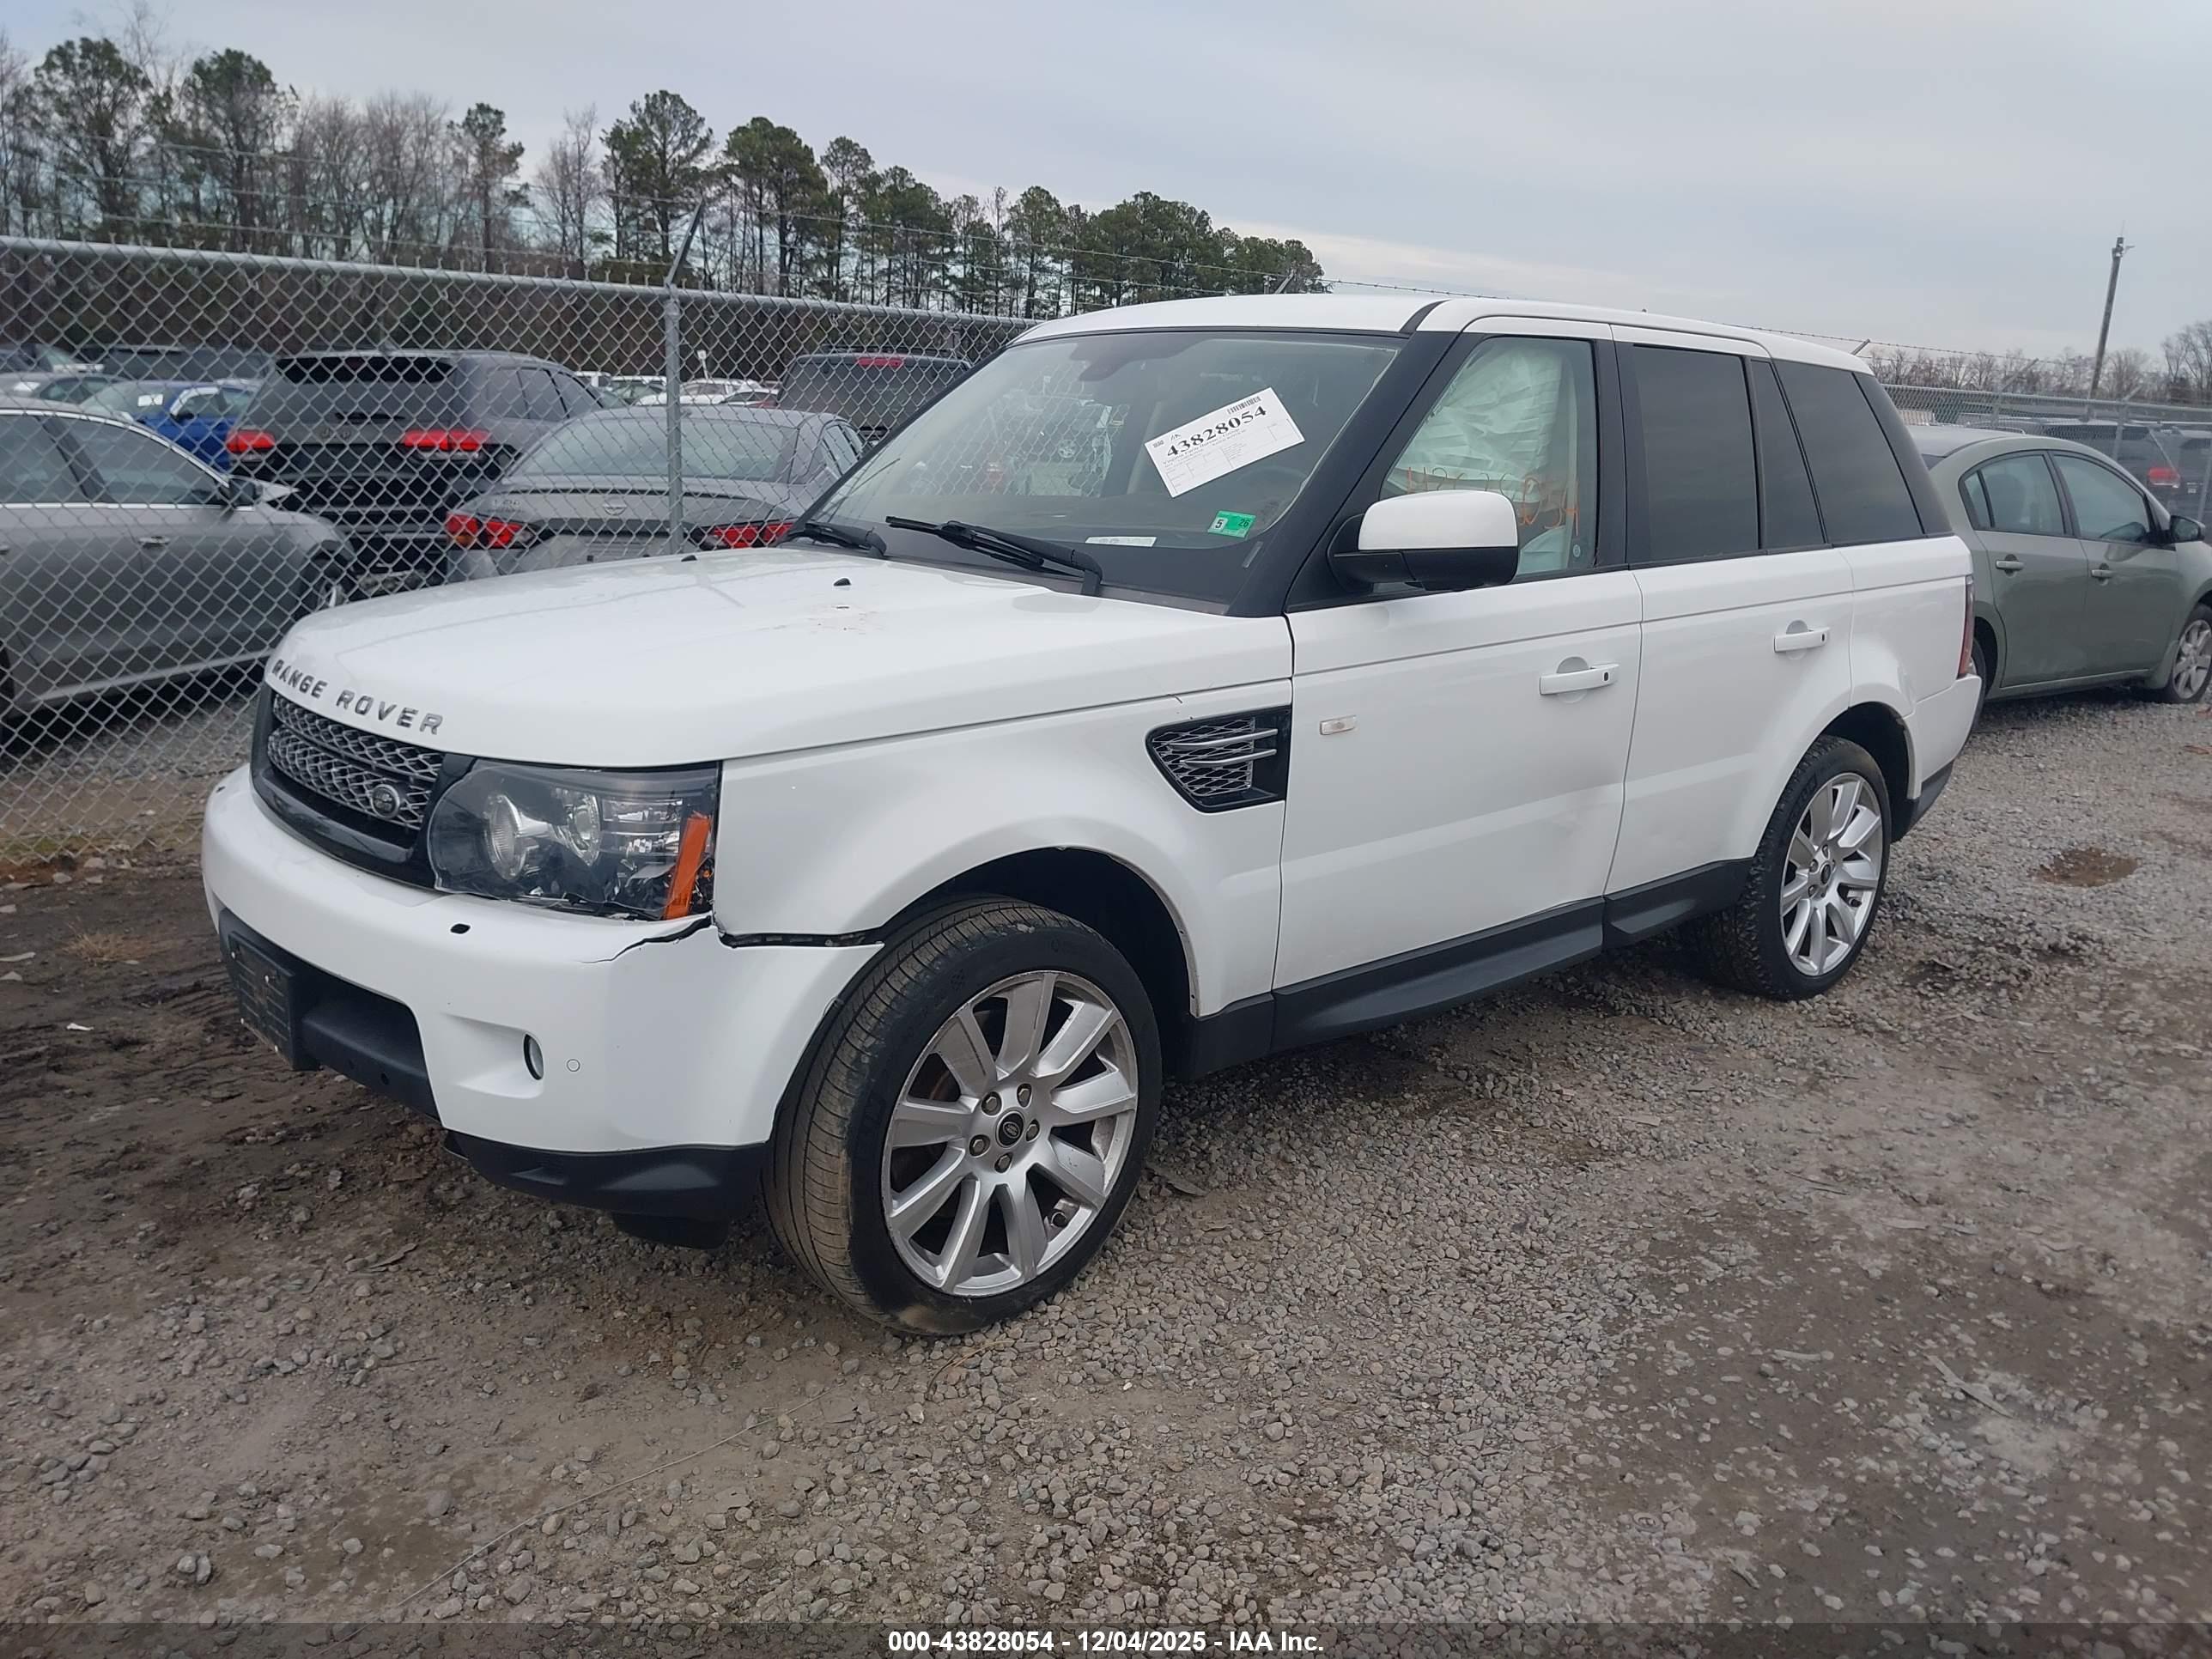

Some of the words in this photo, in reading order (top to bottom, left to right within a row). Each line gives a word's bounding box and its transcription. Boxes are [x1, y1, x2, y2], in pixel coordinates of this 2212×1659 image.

[1166, 405, 1267, 456] 43828054
[1215, 519, 1224, 529] 5
[1238, 518, 1250, 528] 26
[271, 659, 328, 699] RANGE
[336, 689, 444, 735] ROVER
